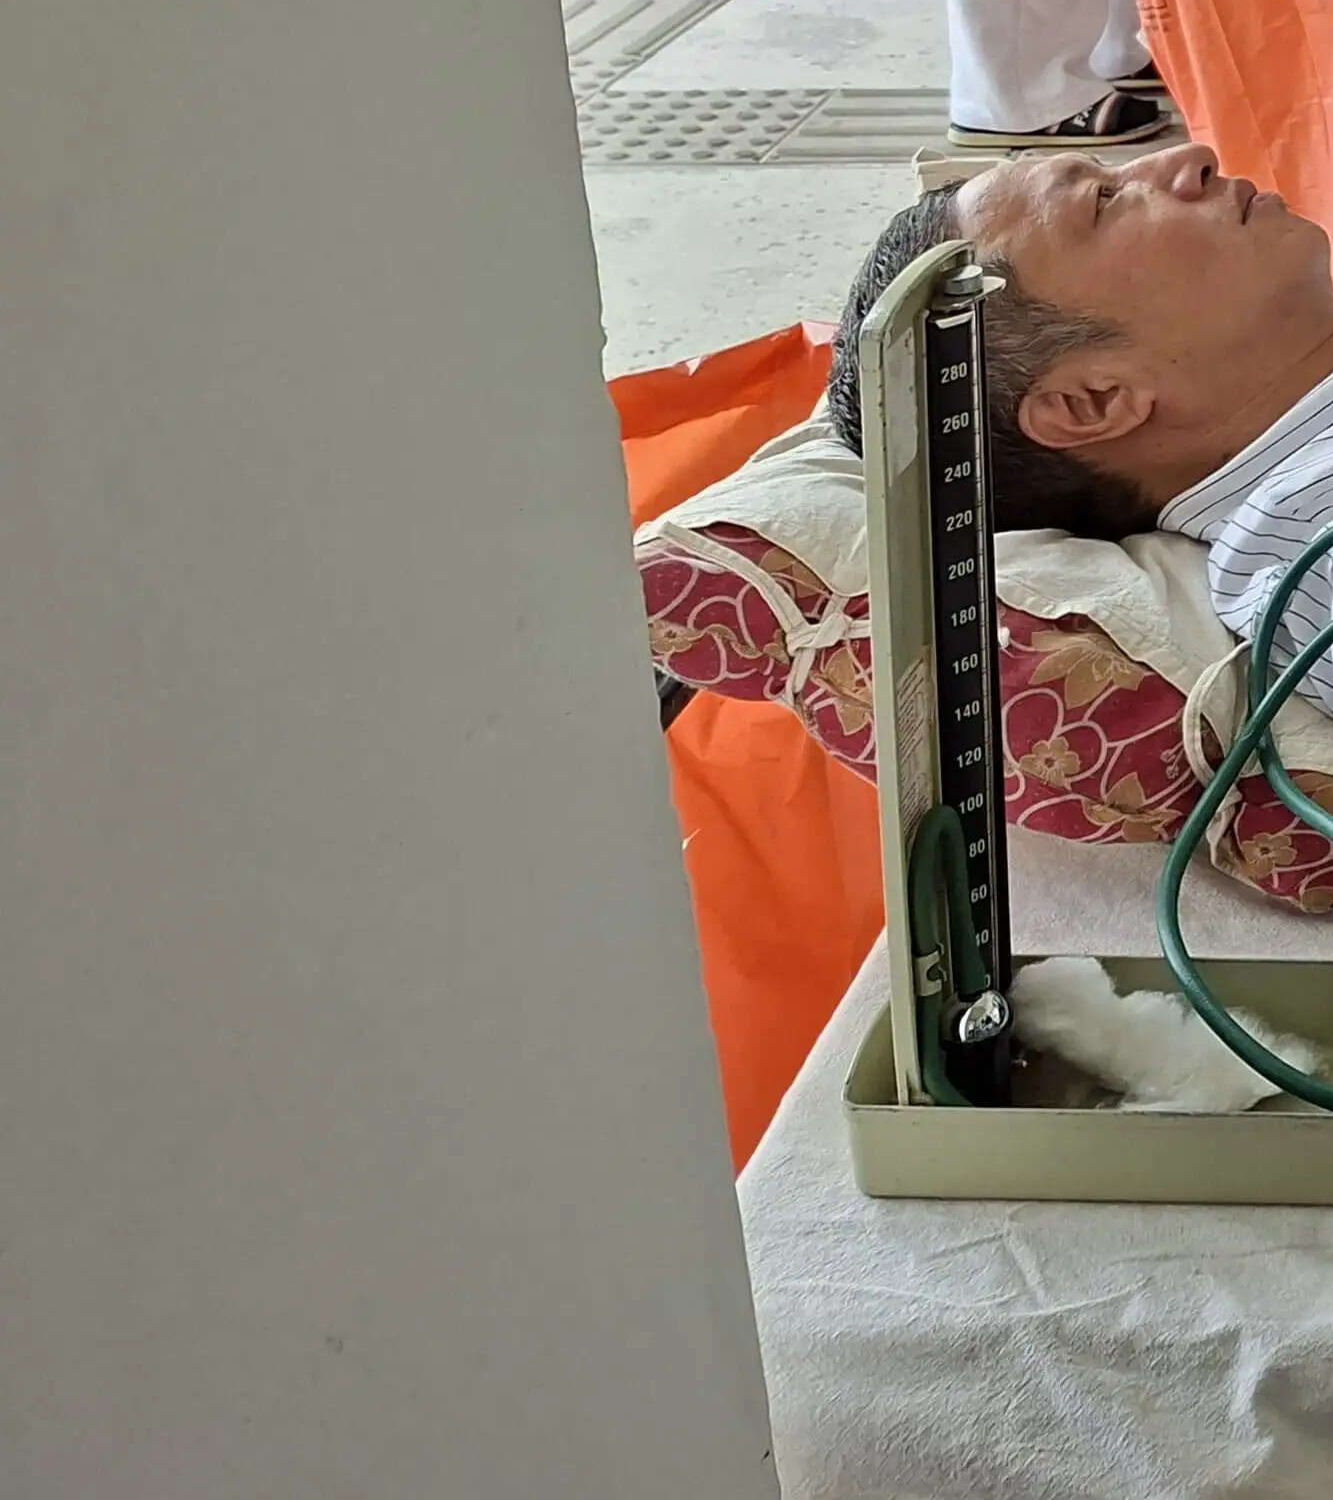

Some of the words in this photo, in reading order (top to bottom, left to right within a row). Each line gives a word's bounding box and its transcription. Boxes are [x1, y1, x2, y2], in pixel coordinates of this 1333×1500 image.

[941, 362, 968, 384] 280
[942, 412, 970, 434] 260
[944, 461, 971, 483] 240
[946, 509, 973, 532] 220
[948, 558, 975, 580] 200
[951, 606, 977, 627] 180
[952, 652, 979, 676] 160
[954, 700, 981, 723] 140
[956, 746, 983, 769] 120
[959, 792, 985, 815] 100
[968, 840, 986, 858] 80
[971, 883, 987, 904] 60
